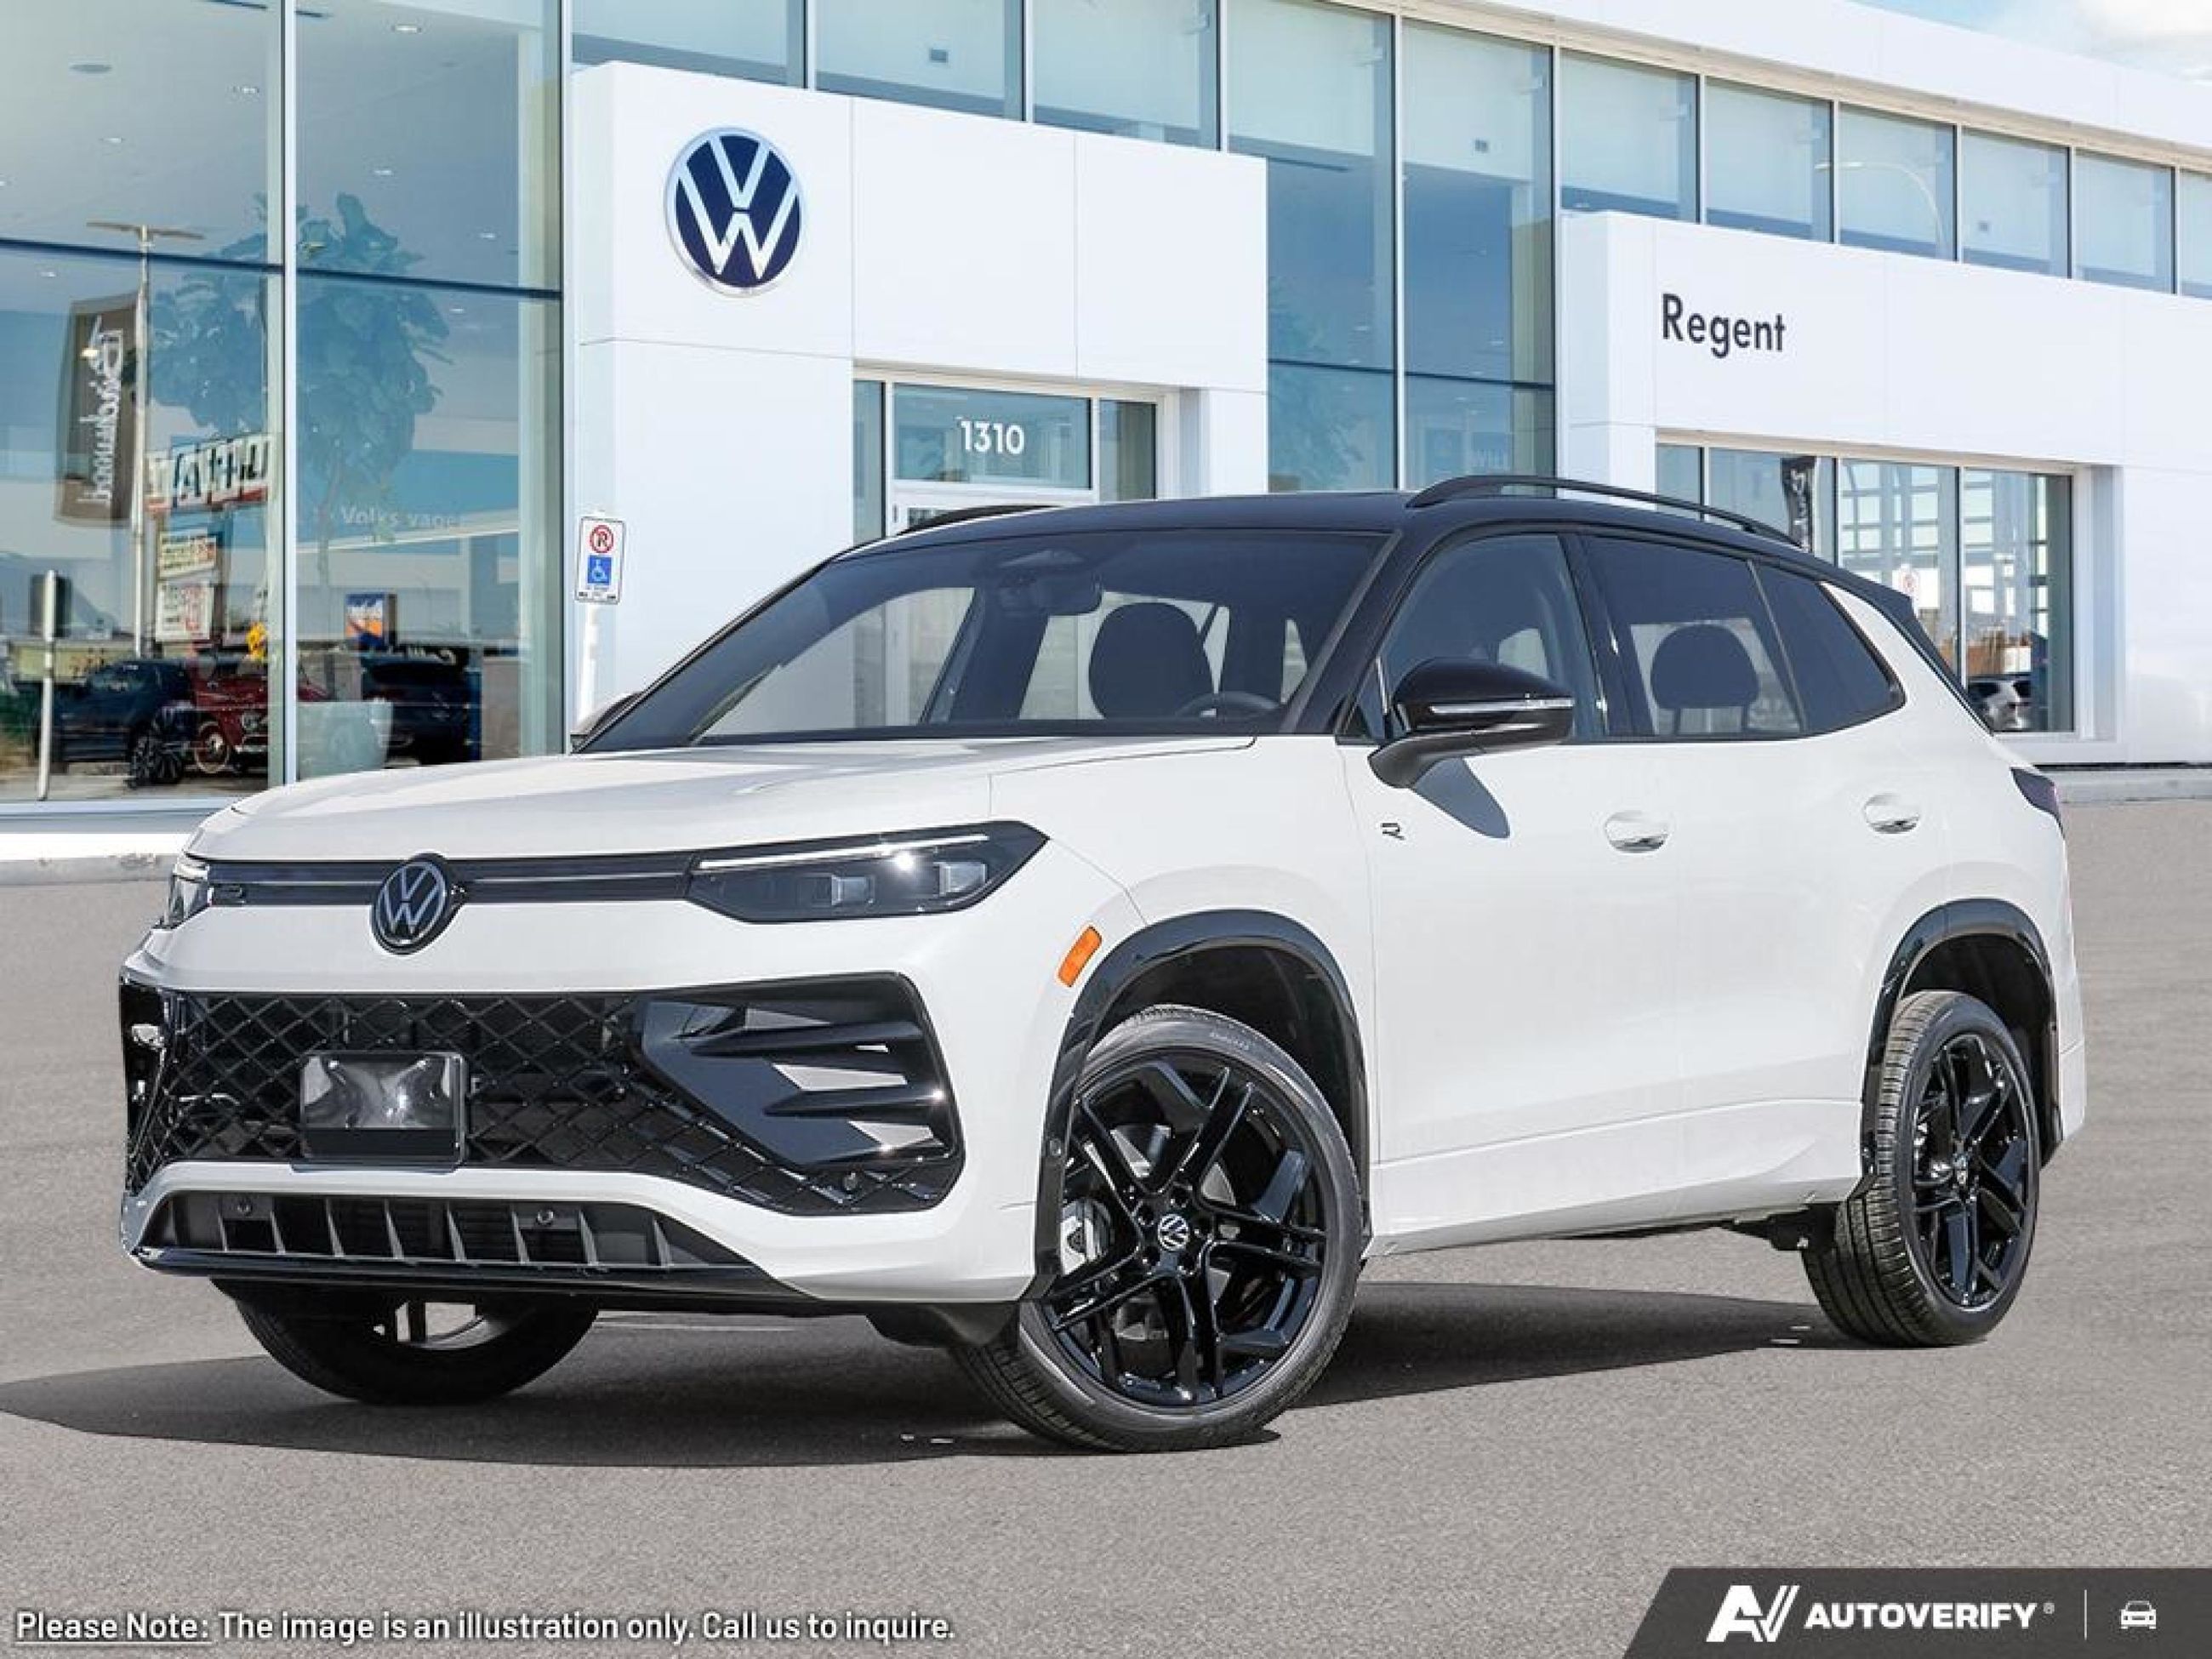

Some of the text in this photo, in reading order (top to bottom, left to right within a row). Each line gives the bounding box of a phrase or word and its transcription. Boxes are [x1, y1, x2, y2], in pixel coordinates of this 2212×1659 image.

[669, 130, 803, 291] VW
[1662, 293, 1787, 359] Regent
[960, 419, 1025, 455] 1310
